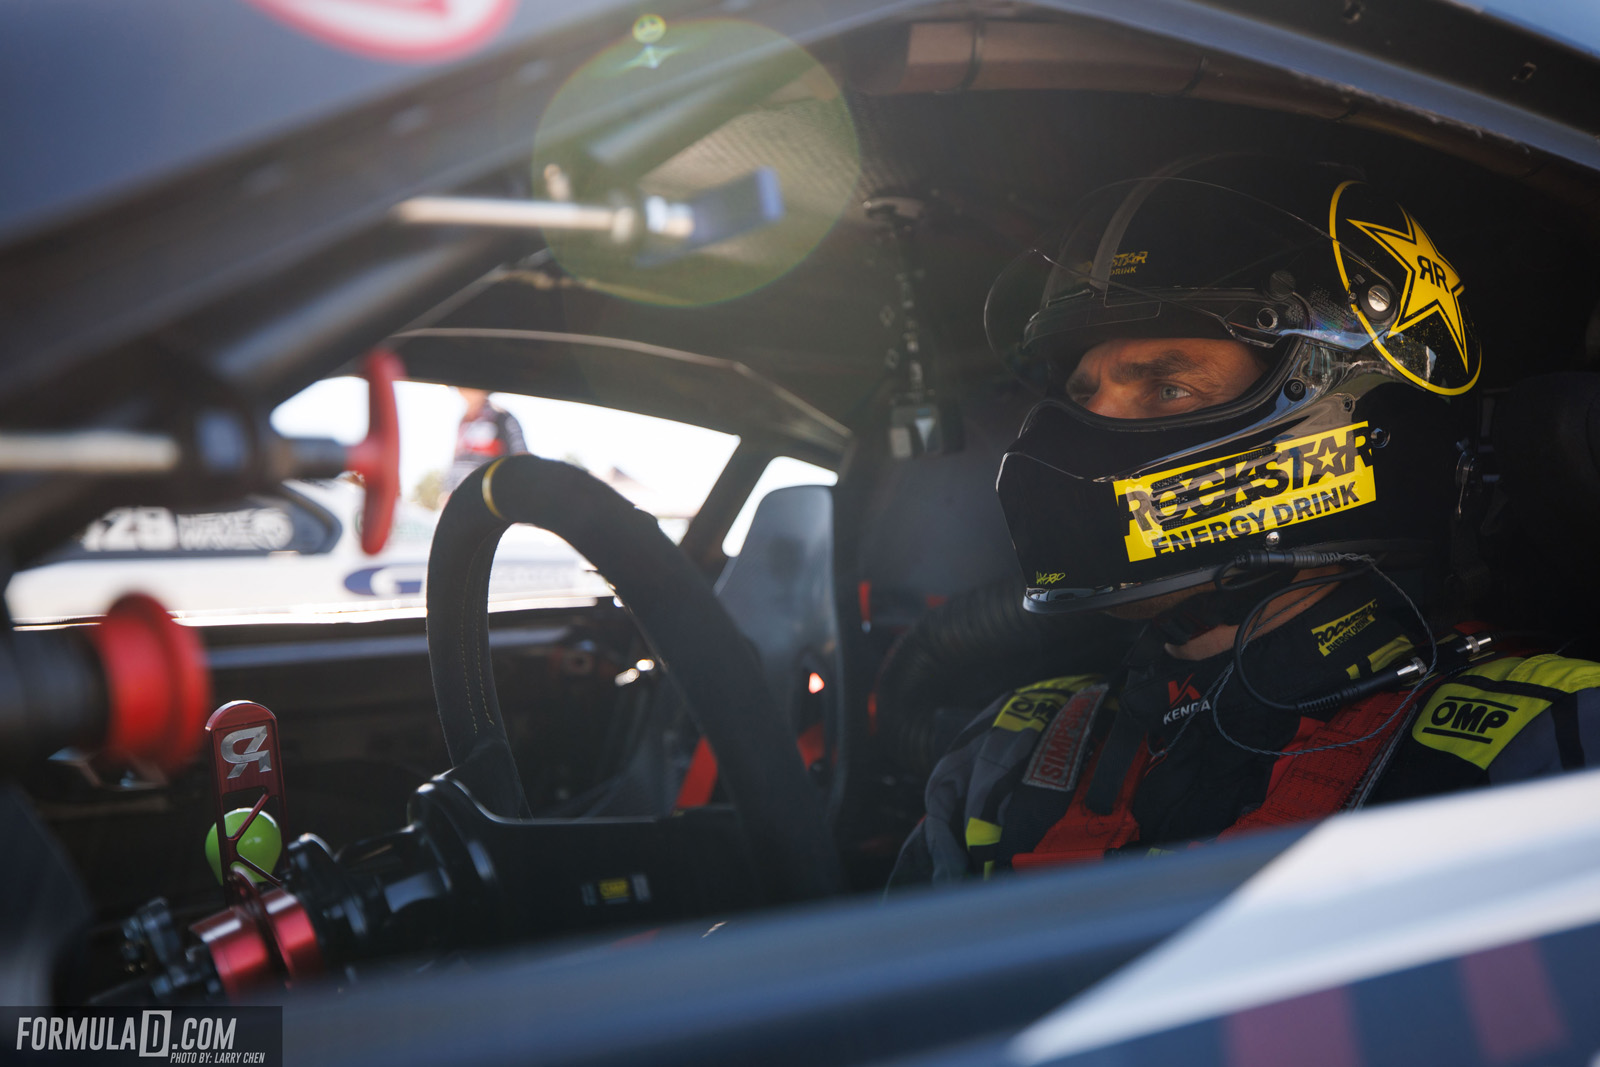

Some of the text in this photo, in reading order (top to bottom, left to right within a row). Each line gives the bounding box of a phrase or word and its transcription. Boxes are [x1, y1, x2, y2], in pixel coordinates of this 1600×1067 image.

[1116, 428, 1374, 533] ROCKSTAR
[1151, 480, 1361, 556] ENERGY DRINK
[1011, 701, 1059, 720] OM
[1163, 700, 1211, 725] KENDA
[1430, 702, 1510, 734] OMP
